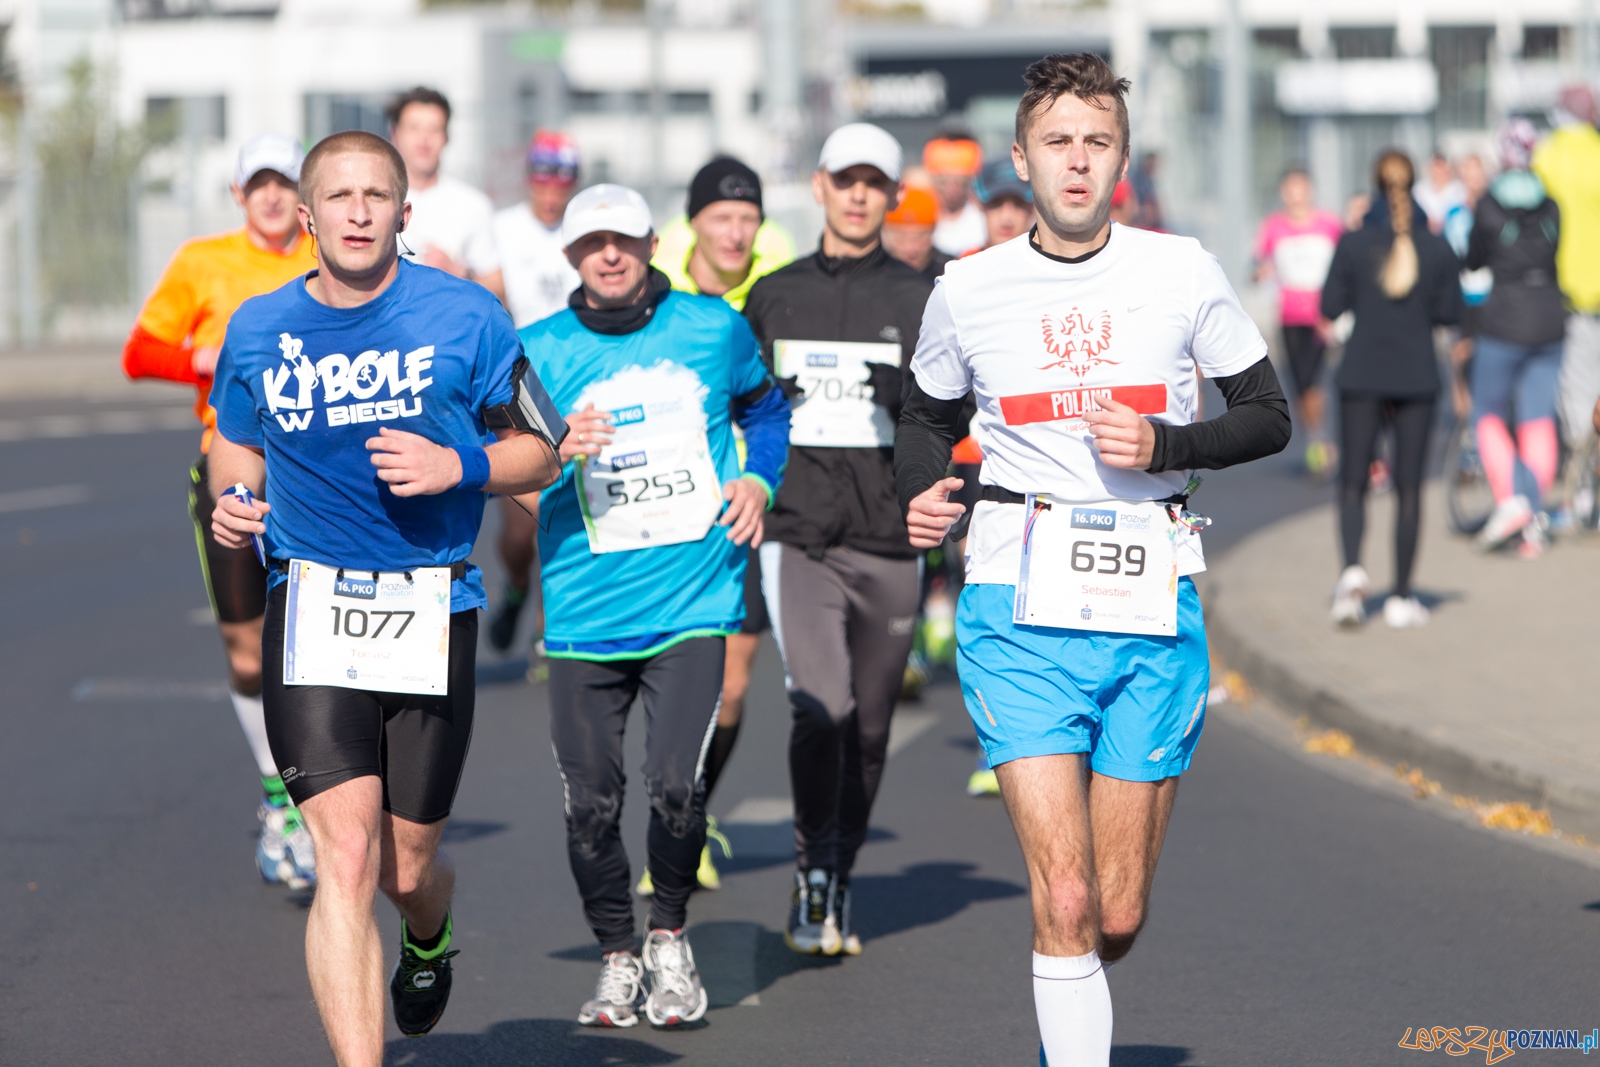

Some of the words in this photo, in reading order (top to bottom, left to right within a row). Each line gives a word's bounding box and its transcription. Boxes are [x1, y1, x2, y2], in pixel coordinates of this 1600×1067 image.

[275, 410, 314, 433] W
[326, 397, 423, 427] BIEGU
[606, 469, 695, 507] 5253
[1074, 513, 1089, 524] 16.
[1090, 514, 1113, 526] PKO
[1120, 521, 1150, 530] maraton
[1070, 540, 1146, 577] 639
[337, 581, 351, 592] 16.
[352, 584, 374, 595] PKO
[380, 589, 414, 597] maraton
[1081, 584, 1132, 598] Sebastian
[331, 606, 416, 639] 1077
[350, 648, 392, 660] Tomasz
[1147, 747, 1166, 763] 4F
